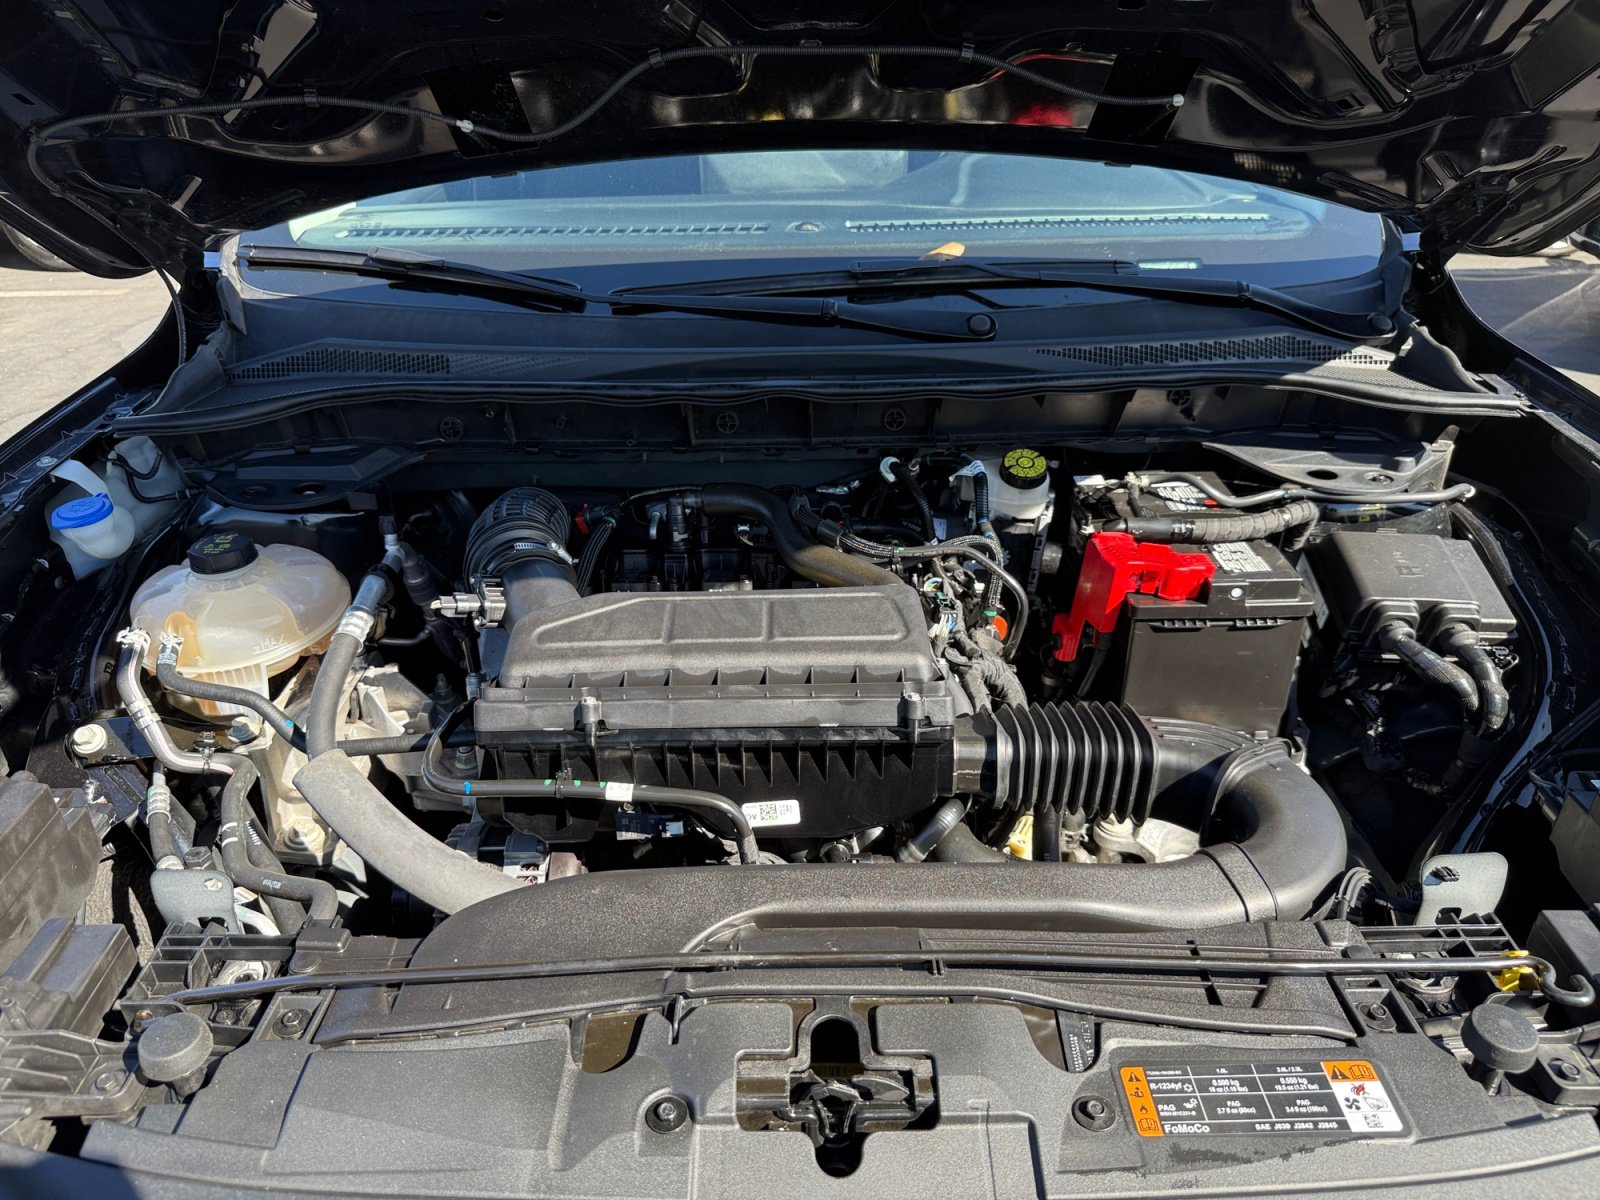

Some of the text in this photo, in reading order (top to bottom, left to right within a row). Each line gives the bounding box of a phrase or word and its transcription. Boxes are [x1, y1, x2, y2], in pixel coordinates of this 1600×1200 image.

[1230, 1078, 1240, 1087] kg
[1298, 1077, 1308, 1085] kg
[1149, 1082, 1182, 1091] R-1234yf
[1163, 1124, 1210, 1133] FoMoCo
